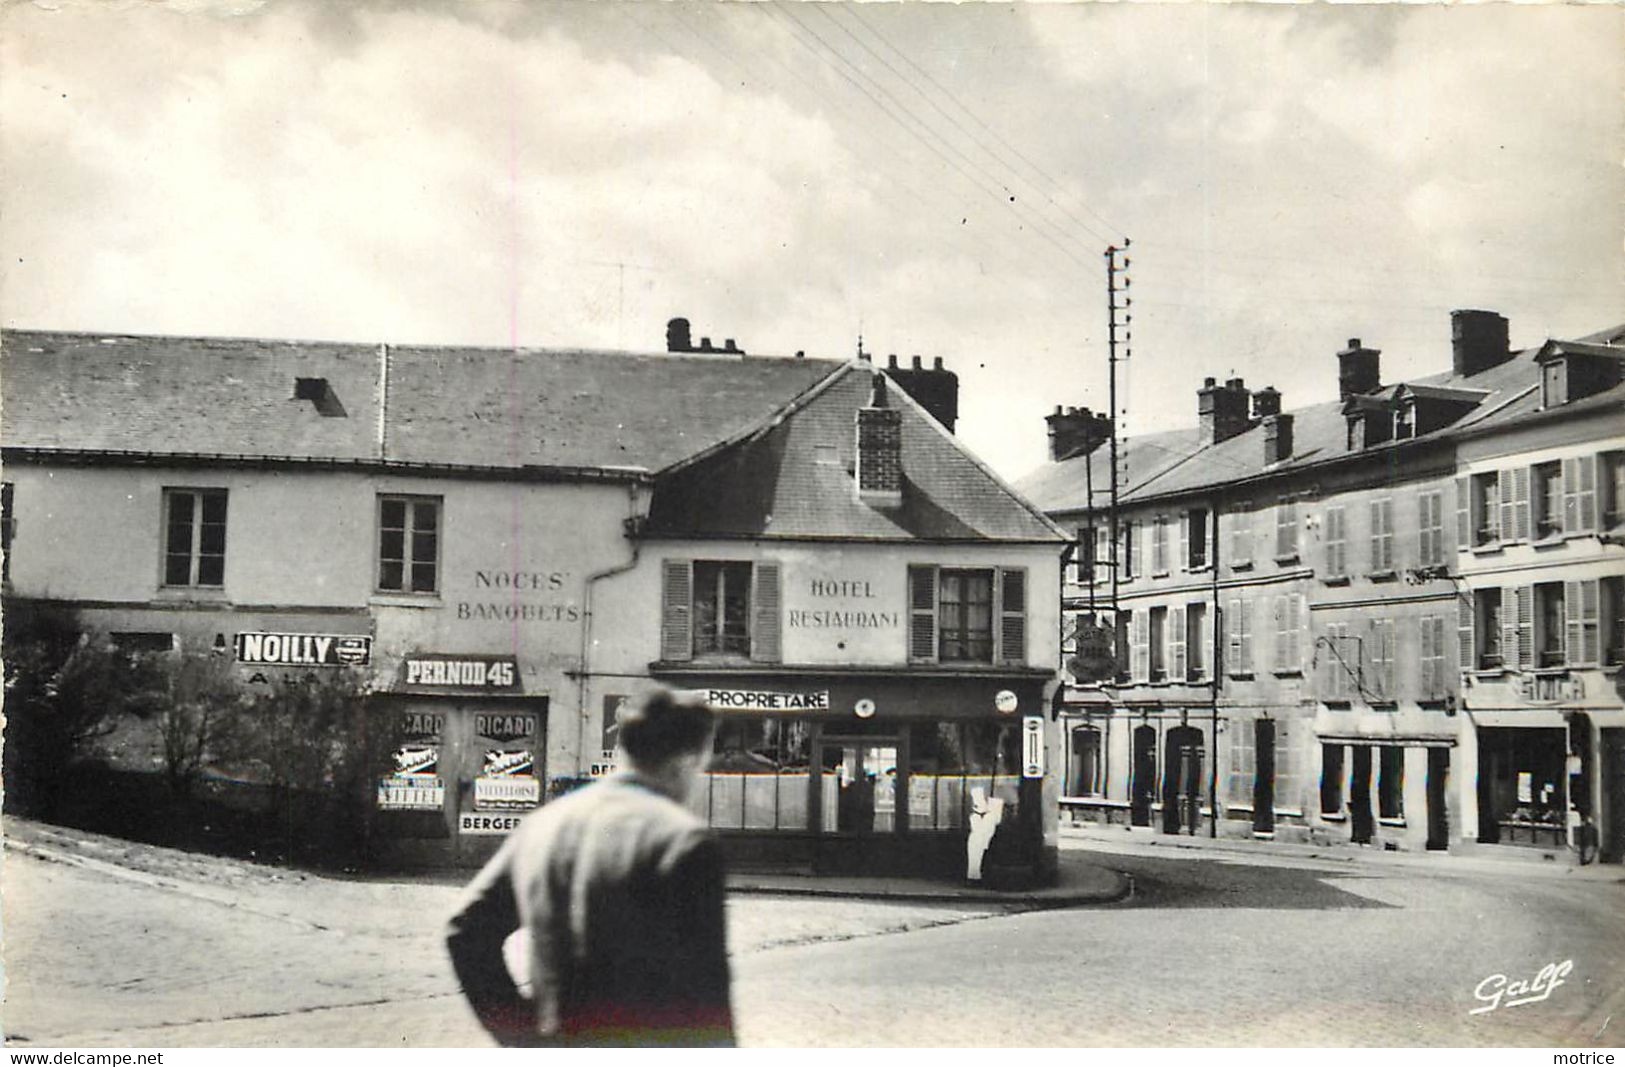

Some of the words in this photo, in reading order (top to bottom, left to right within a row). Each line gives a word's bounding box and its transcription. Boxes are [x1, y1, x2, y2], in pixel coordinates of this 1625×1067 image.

[475, 571, 562, 590] NOCES
[811, 580, 876, 598] HOTEL
[457, 602, 578, 622] BANQUETS
[789, 609, 898, 628] RESTAURANT
[244, 634, 332, 663] NOILLY
[406, 660, 487, 685] PERNOD
[487, 662, 514, 686] 45
[709, 690, 827, 708] PROPRIETAIRE
[476, 715, 535, 736] RICARD
